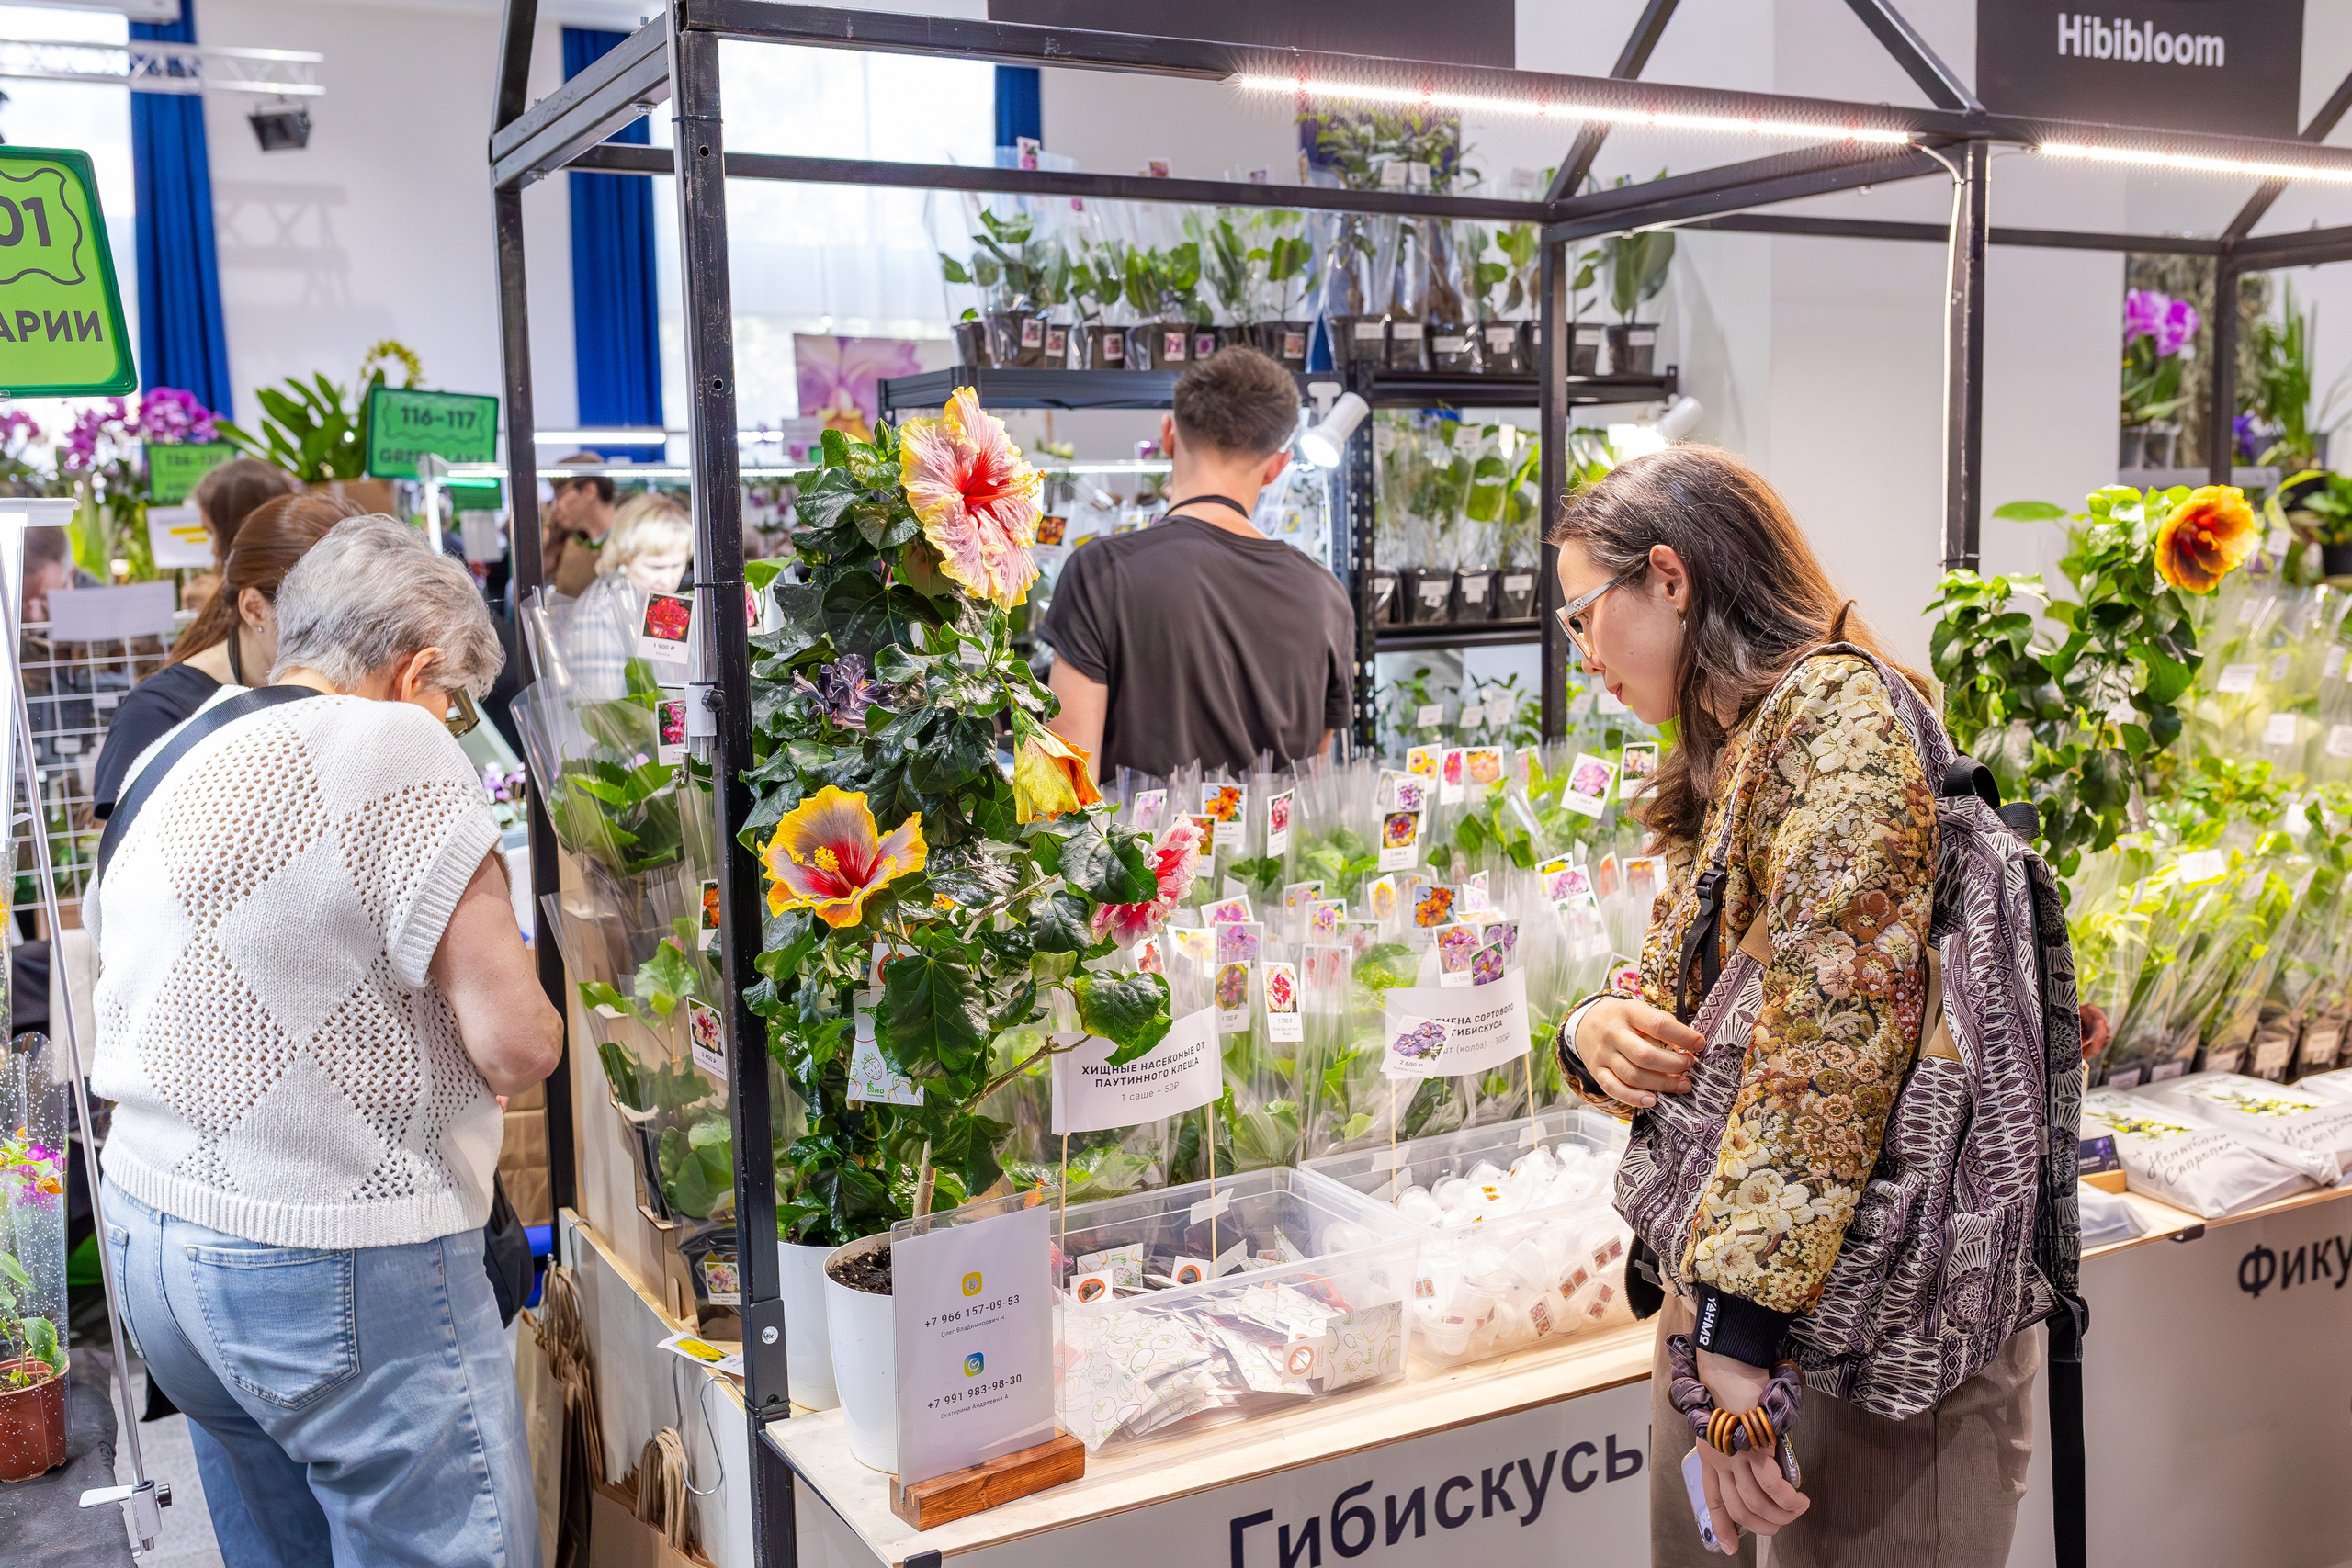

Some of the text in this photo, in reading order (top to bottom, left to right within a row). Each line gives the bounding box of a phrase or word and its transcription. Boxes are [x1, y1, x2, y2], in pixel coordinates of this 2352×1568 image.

[2058, 12, 2225, 67] Hibibloom
[401, 405, 476, 430] 116-117
[1475, 1003, 1514, 1022] СОРТОВОГО
[1452, 1020, 1503, 1037] ГИБИСКУСА
[1081, 1041, 1205, 1076] ХИЩНЫЕ НАСЕКОМЫЕ ОТ
[1456, 1040, 1487, 1055] (колба)
[1095, 1056, 1200, 1088] ПАУТИННОГО КЛЕЩА
[1129, 1090, 1154, 1101] саше
[2239, 1235, 2352, 1299] Фику
[924, 1294, 1020, 1328] +7 966 157-09-53
[941, 1328, 955, 1337] Олег
[956, 1317, 1000, 1333] Владимирович
[927, 1373, 1022, 1410] +7 991 983-98-30
[941, 1405, 971, 1419] Екатерина
[972, 1396, 1003, 1410] Андреевна
